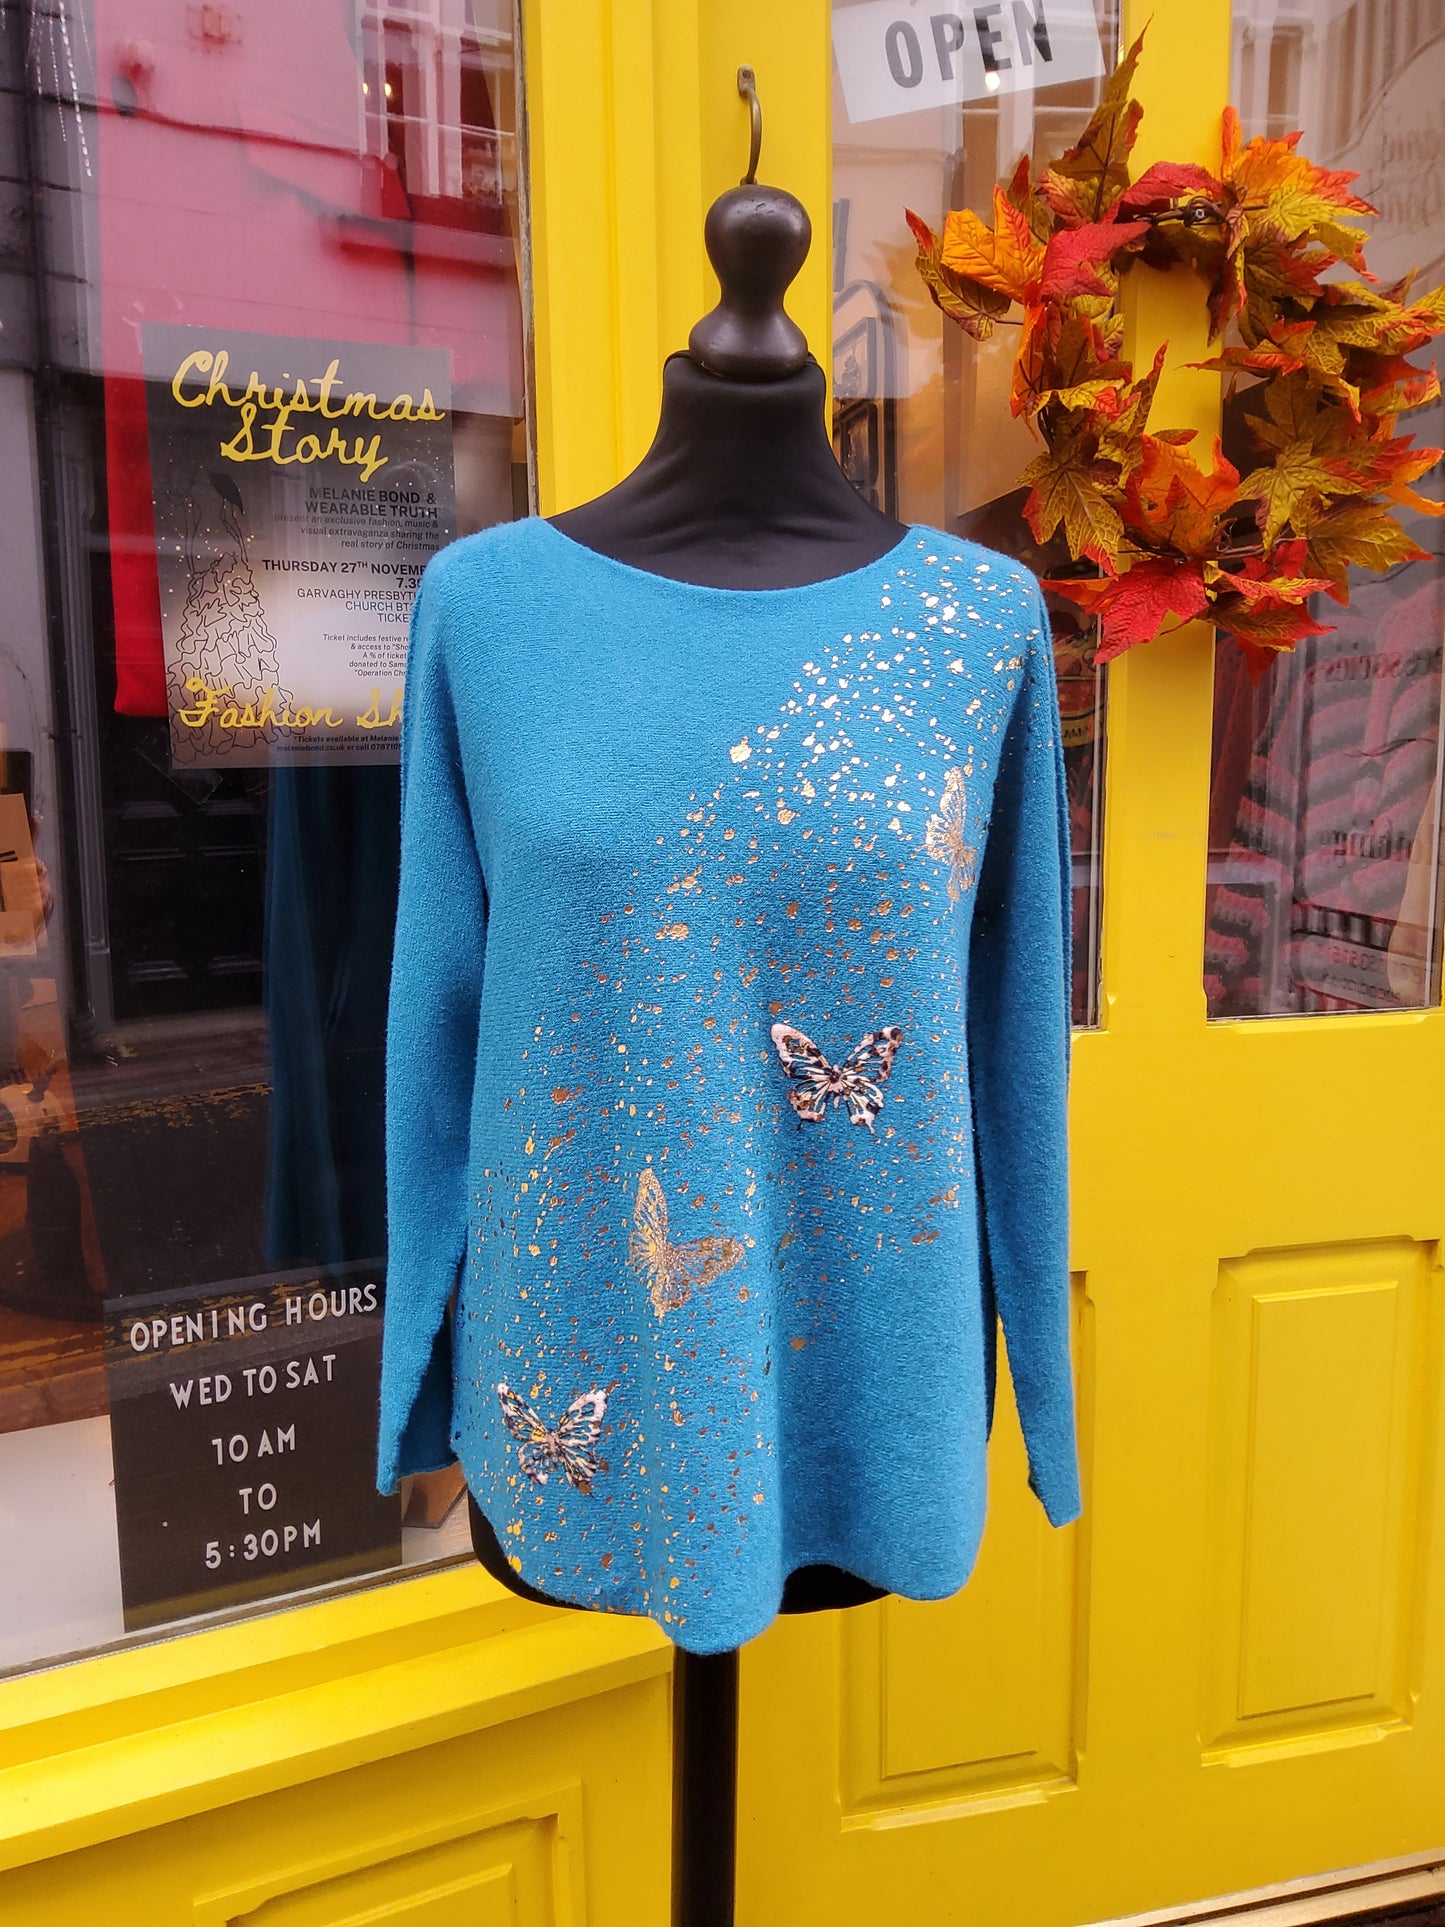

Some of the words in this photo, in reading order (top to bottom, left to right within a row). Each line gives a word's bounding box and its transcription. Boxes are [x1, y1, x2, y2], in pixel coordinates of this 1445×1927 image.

[885, 0, 1053, 88] OPEN
[171, 350, 446, 421] Christmas
[220, 403, 388, 482] Story
[309, 487, 375, 500] MELANIE
[379, 490, 420, 504] BOND
[426, 493, 436, 505] &
[305, 501, 387, 517] WEARABLE
[390, 505, 438, 519] TRUTH
[324, 516, 367, 525] exclusive
[405, 520, 430, 528] music
[432, 520, 438, 528] &
[329, 527, 388, 538] extravaganza
[391, 529, 423, 540] sharing
[425, 530, 440, 540] the
[341, 539, 358, 548] real
[361, 540, 383, 550] story
[385, 540, 394, 549] of
[396, 541, 440, 551] Christmas
[262, 559, 338, 573] THURSDAY
[341, 561, 368, 573] 27TH
[297, 588, 361, 600] GARVAGHY
[345, 600, 393, 612] CHURCH
[323, 633, 345, 641] Ticket
[347, 634, 376, 642] includes
[378, 634, 402, 642] festive
[349, 660, 378, 668] donated
[178, 677, 343, 729] Fashion
[326, 735, 359, 743] available
[370, 734, 399, 742] Melanie
[355, 743, 370, 751] call
[130, 1303, 268, 1352] OPENING
[285, 1284, 378, 1326] HOURS
[169, 1374, 232, 1410] WED
[243, 1365, 278, 1397] TO
[286, 1354, 337, 1389] SAT
[239, 1483, 278, 1515] TO
[205, 1519, 322, 1570] 5:30PM
